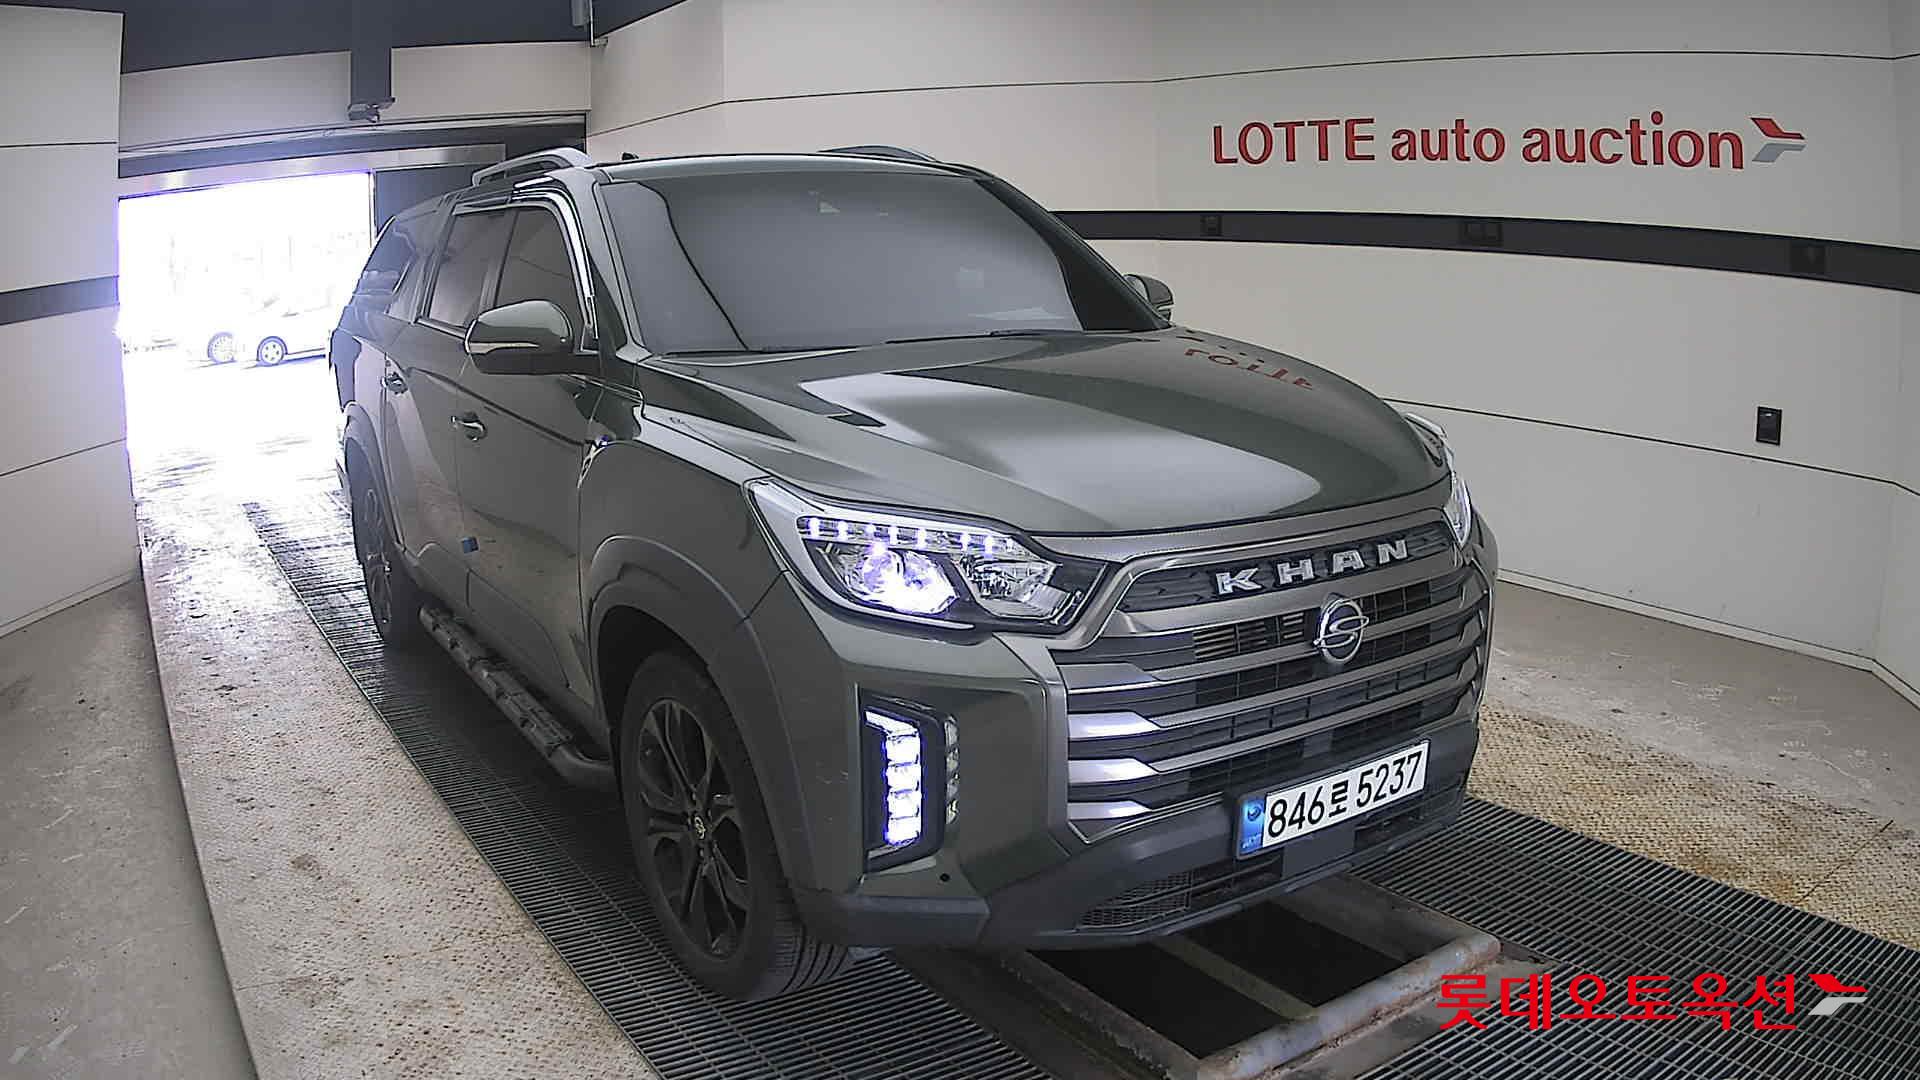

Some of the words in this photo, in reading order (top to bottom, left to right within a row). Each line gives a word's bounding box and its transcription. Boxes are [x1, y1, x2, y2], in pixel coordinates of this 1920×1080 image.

[1213, 119, 1375, 164] LOTTE
[1391, 118, 1504, 163] auto
[1522, 111, 1745, 169] auction
[1216, 540, 1409, 595] KHAN
[1268, 780, 1348, 838] 846로
[1356, 751, 1423, 808] 5237
